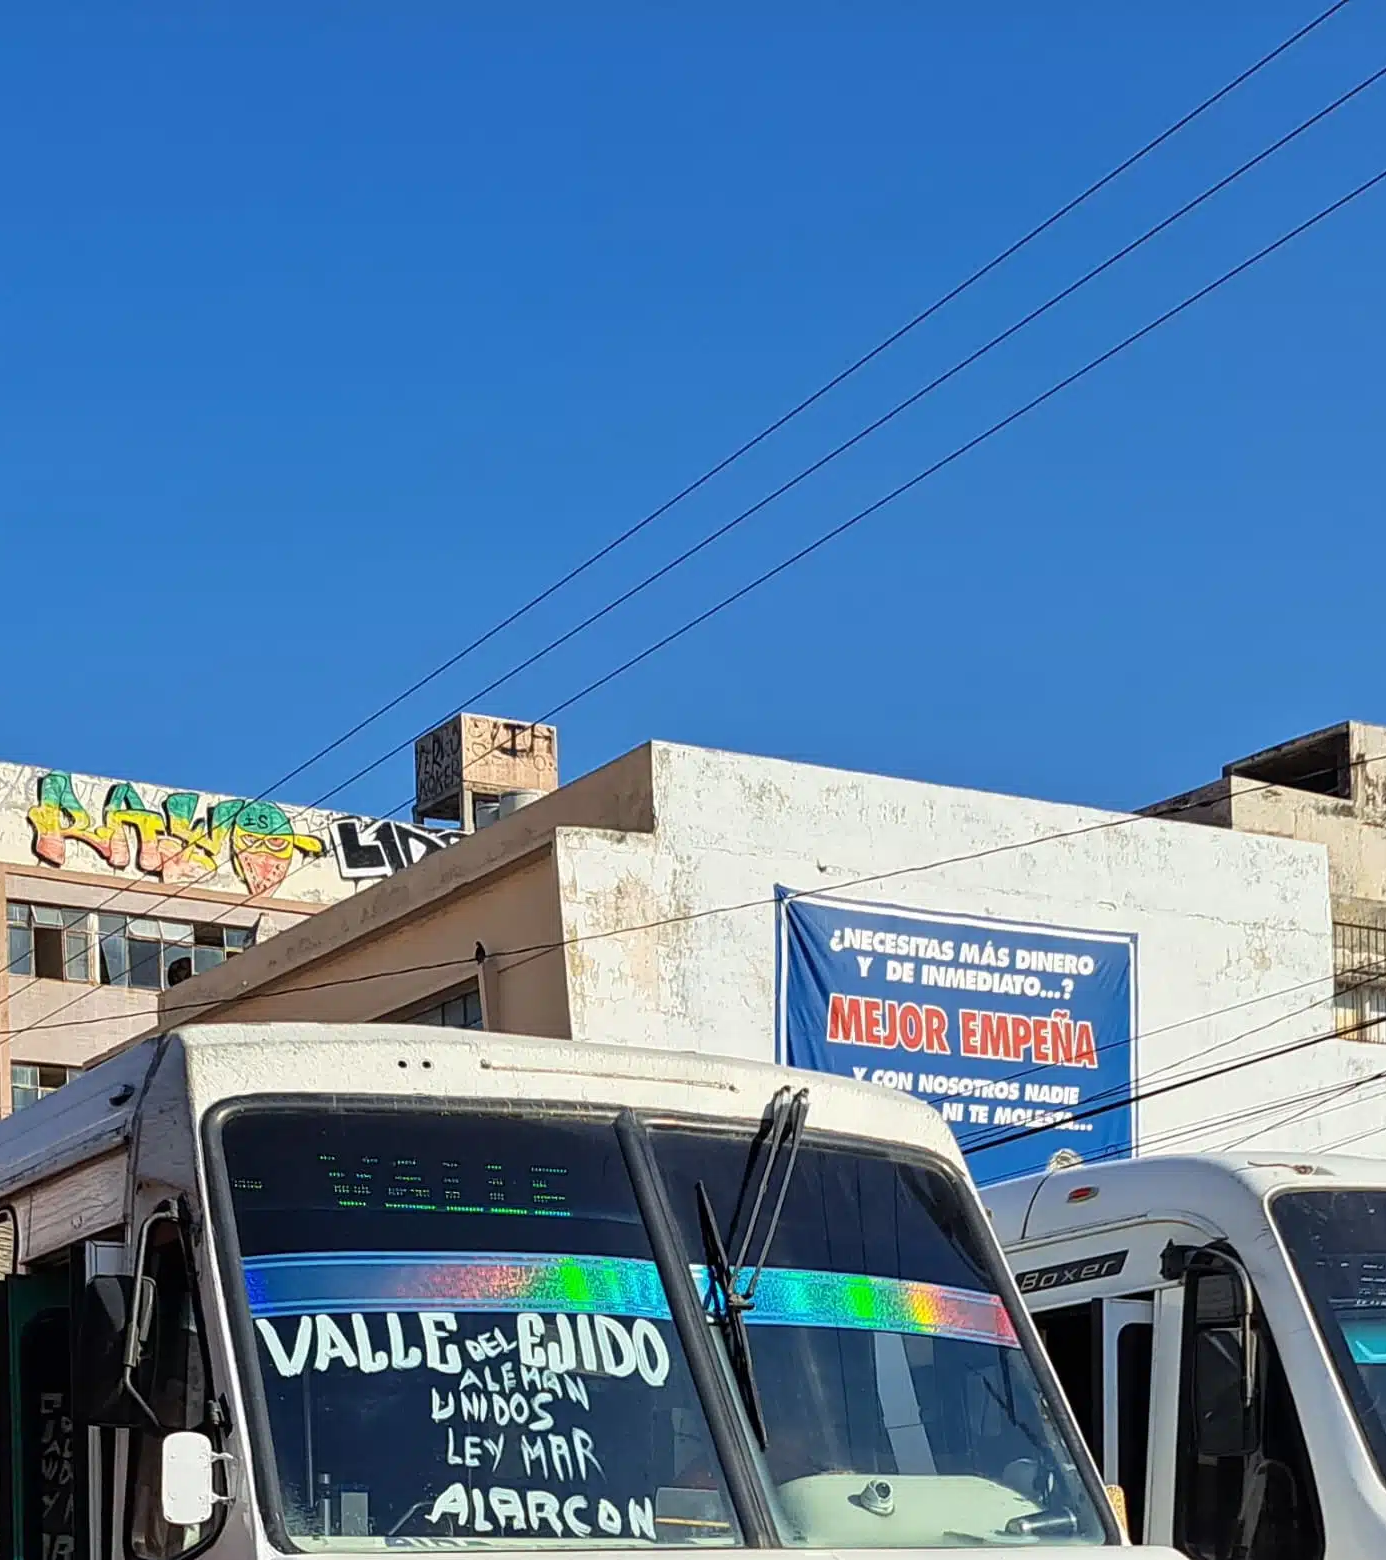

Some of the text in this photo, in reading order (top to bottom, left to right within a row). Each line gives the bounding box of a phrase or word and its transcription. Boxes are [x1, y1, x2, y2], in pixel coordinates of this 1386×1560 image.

[830, 928, 1094, 975] ¿NECESITAS MÁS DINERO
[857, 956, 1074, 1000] Y DE INMEDIATO...?
[827, 993, 1098, 1069] MEJOR EMPEÑA
[871, 1070, 913, 1091] CON
[918, 1074, 1020, 1100] NOSOTROS
[1025, 1081, 1080, 1104] NADIE
[943, 1102, 963, 1122] NI
[969, 1104, 989, 1124] TE
[1020, 1260, 1116, 1291] Boxer
[255, 1311, 670, 1387] VALLE DEL EJIDO
[431, 1387, 555, 1431] UNIDOS
[459, 1362, 590, 1411] ALEMAN
[447, 1426, 608, 1484] LEY MAR
[425, 1482, 657, 1541] ALARCON
